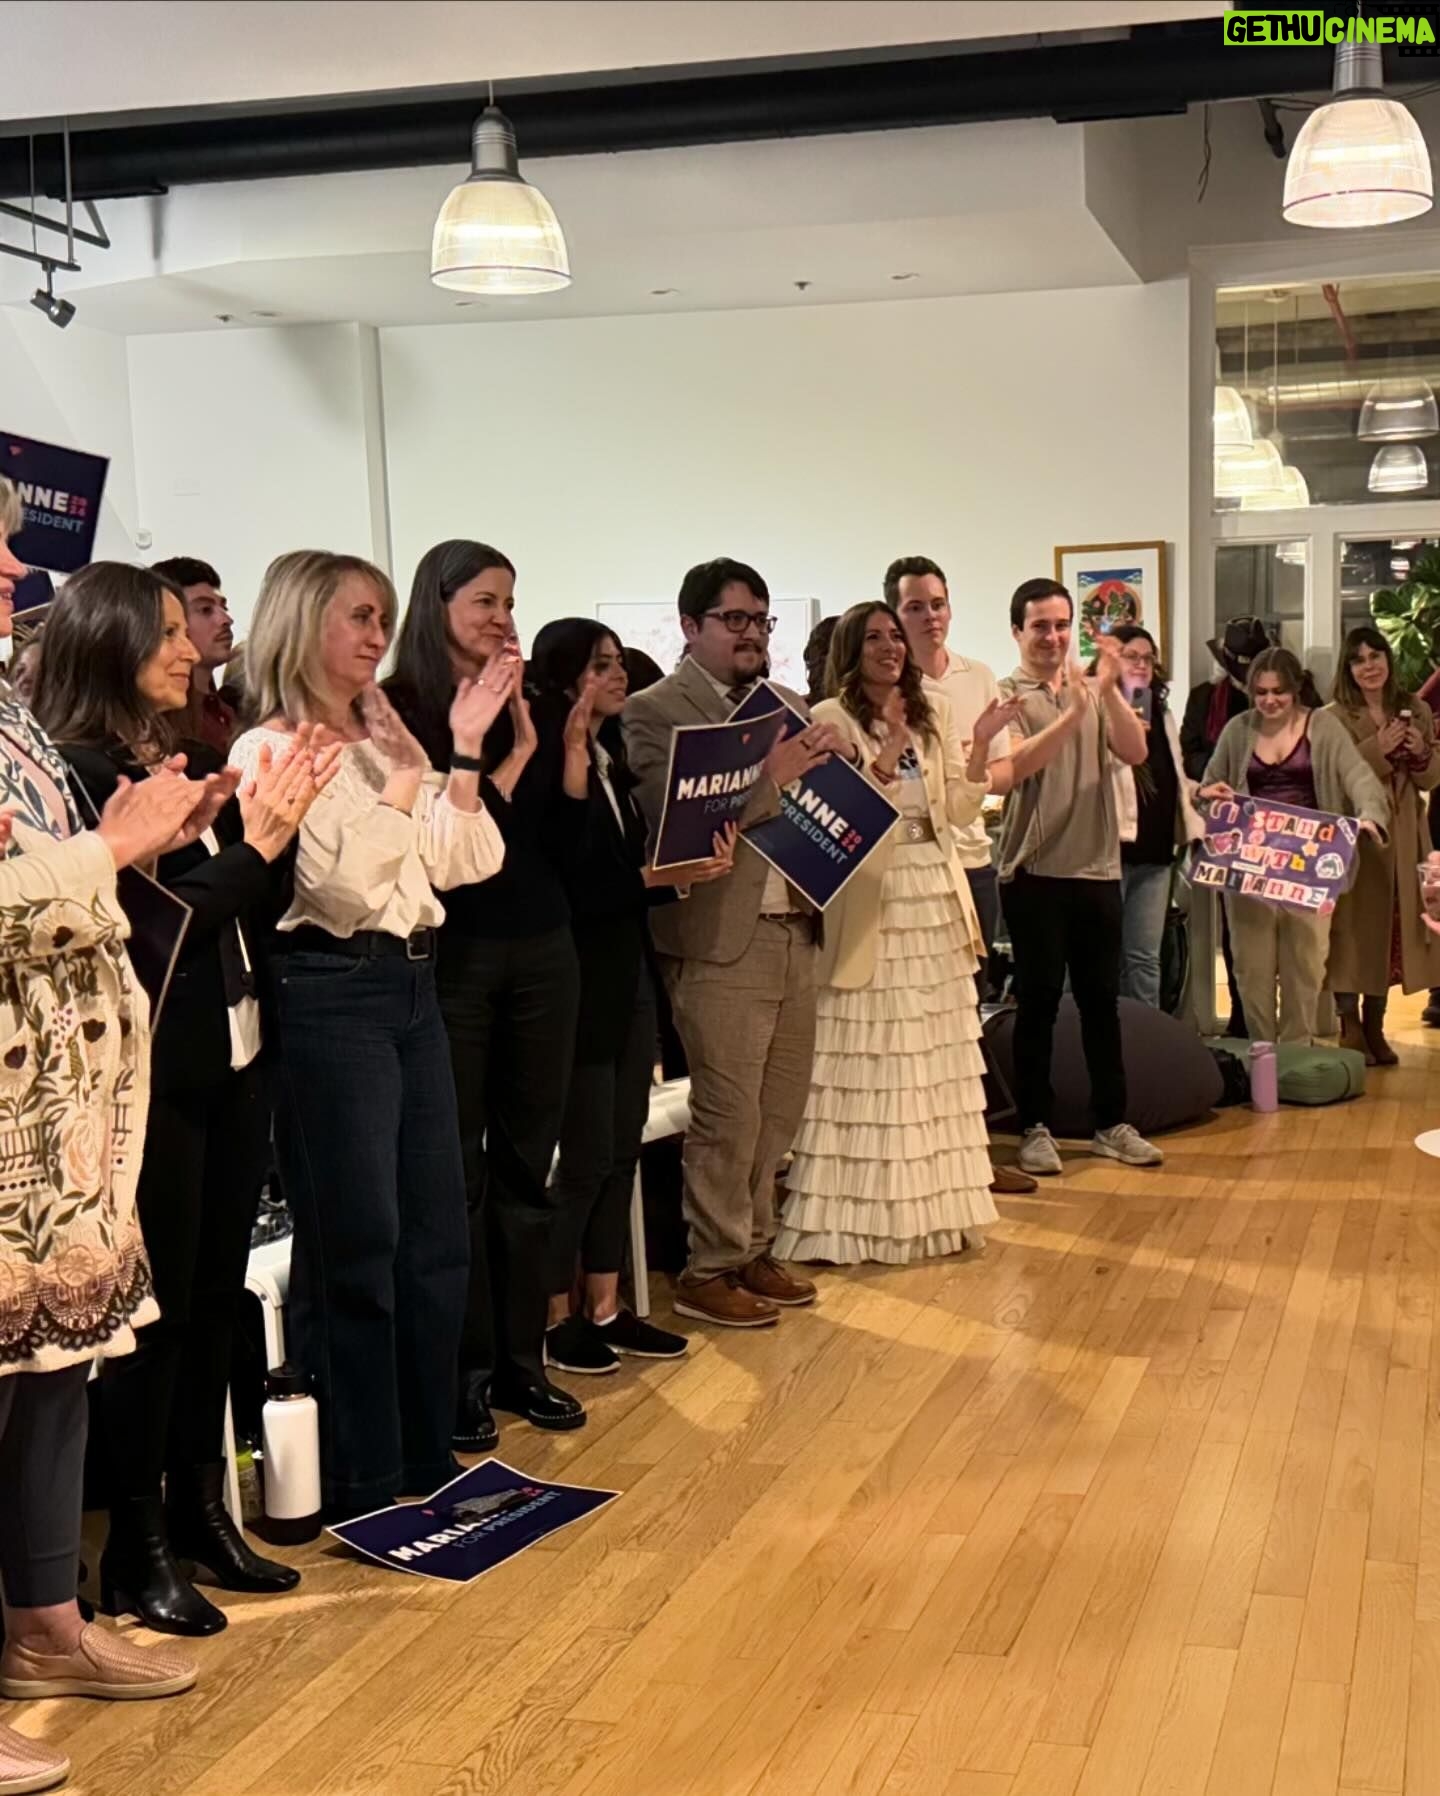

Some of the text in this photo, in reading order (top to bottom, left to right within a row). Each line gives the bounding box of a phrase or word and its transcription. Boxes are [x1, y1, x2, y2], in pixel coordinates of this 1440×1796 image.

[18, 481, 70, 513] NNE
[23, 507, 84, 533] ESIDENT
[781, 778, 849, 839] ANNE
